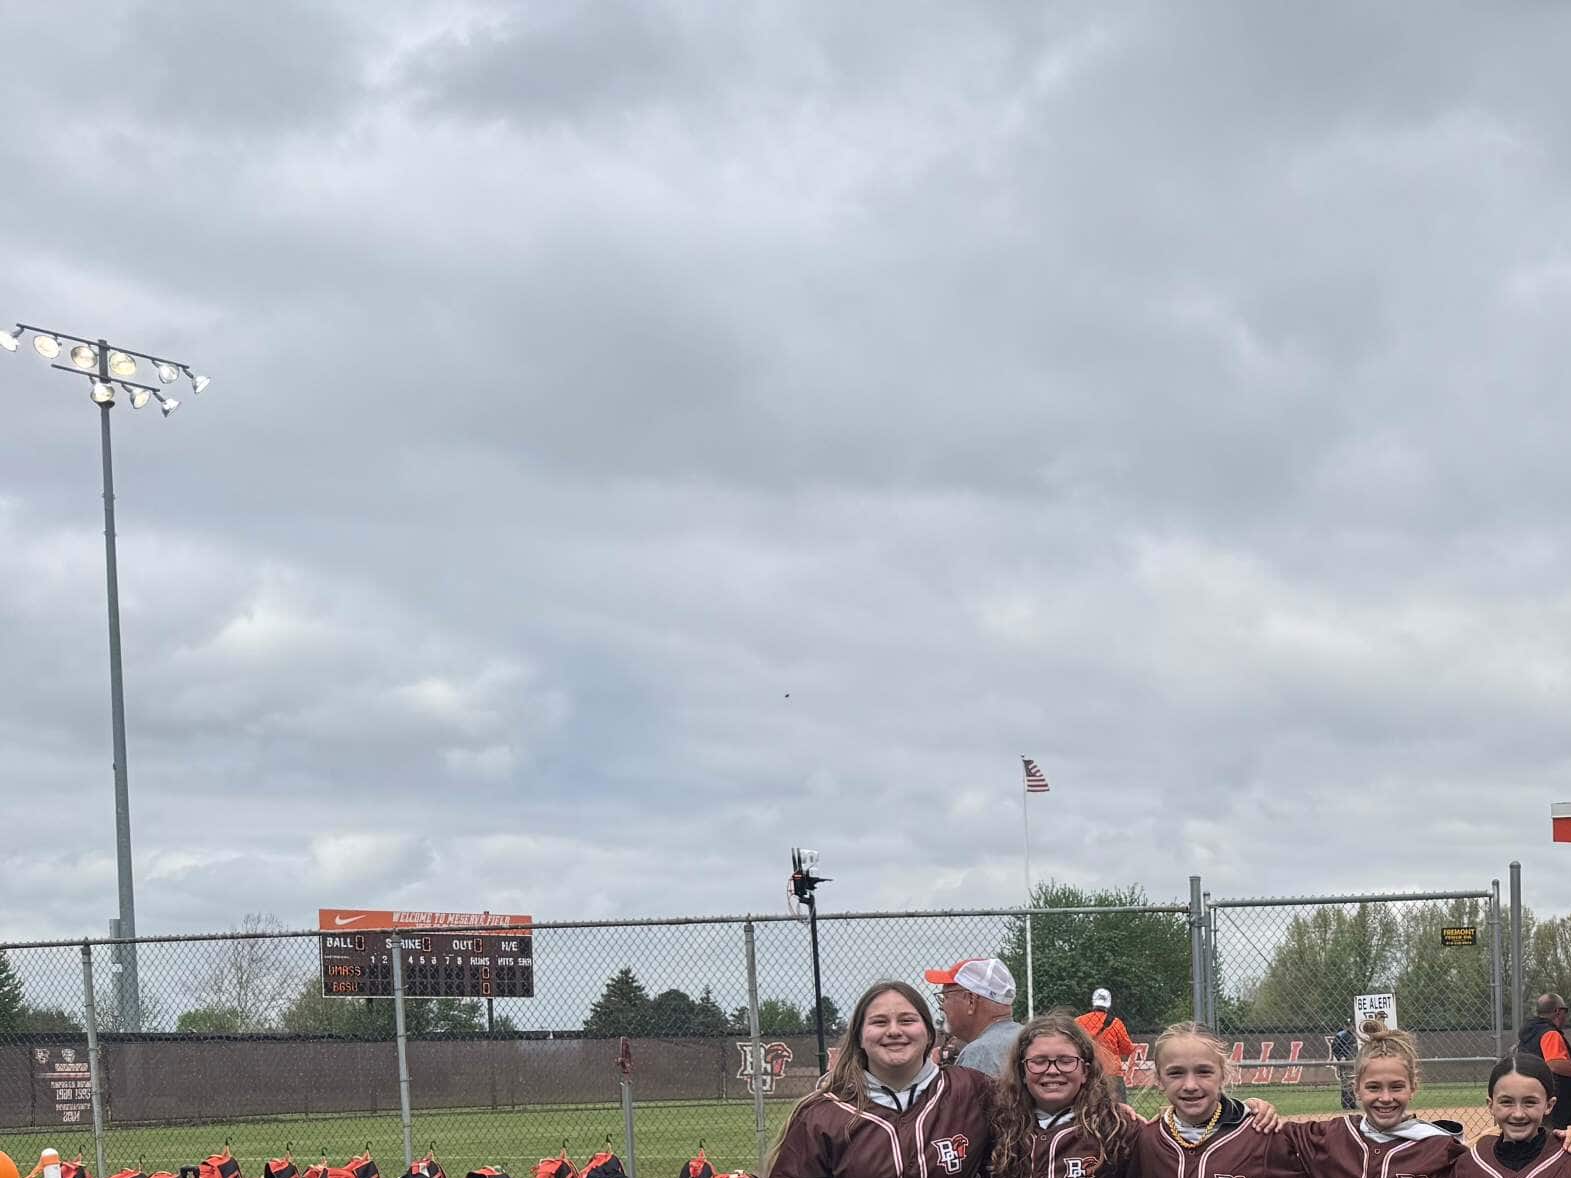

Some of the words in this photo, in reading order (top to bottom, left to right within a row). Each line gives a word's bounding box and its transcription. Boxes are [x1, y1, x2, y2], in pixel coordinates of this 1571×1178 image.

[393, 911, 433, 924] WELCOME
[434, 912, 445, 924] TO
[486, 914, 511, 926] FIELD
[326, 938, 353, 948] BALL
[386, 939, 422, 950] SRIKE
[452, 940, 473, 950] OUT
[470, 956, 490, 966] RUNS
[1357, 998, 1367, 1010] BE
[1369, 996, 1391, 1009] ALERT
